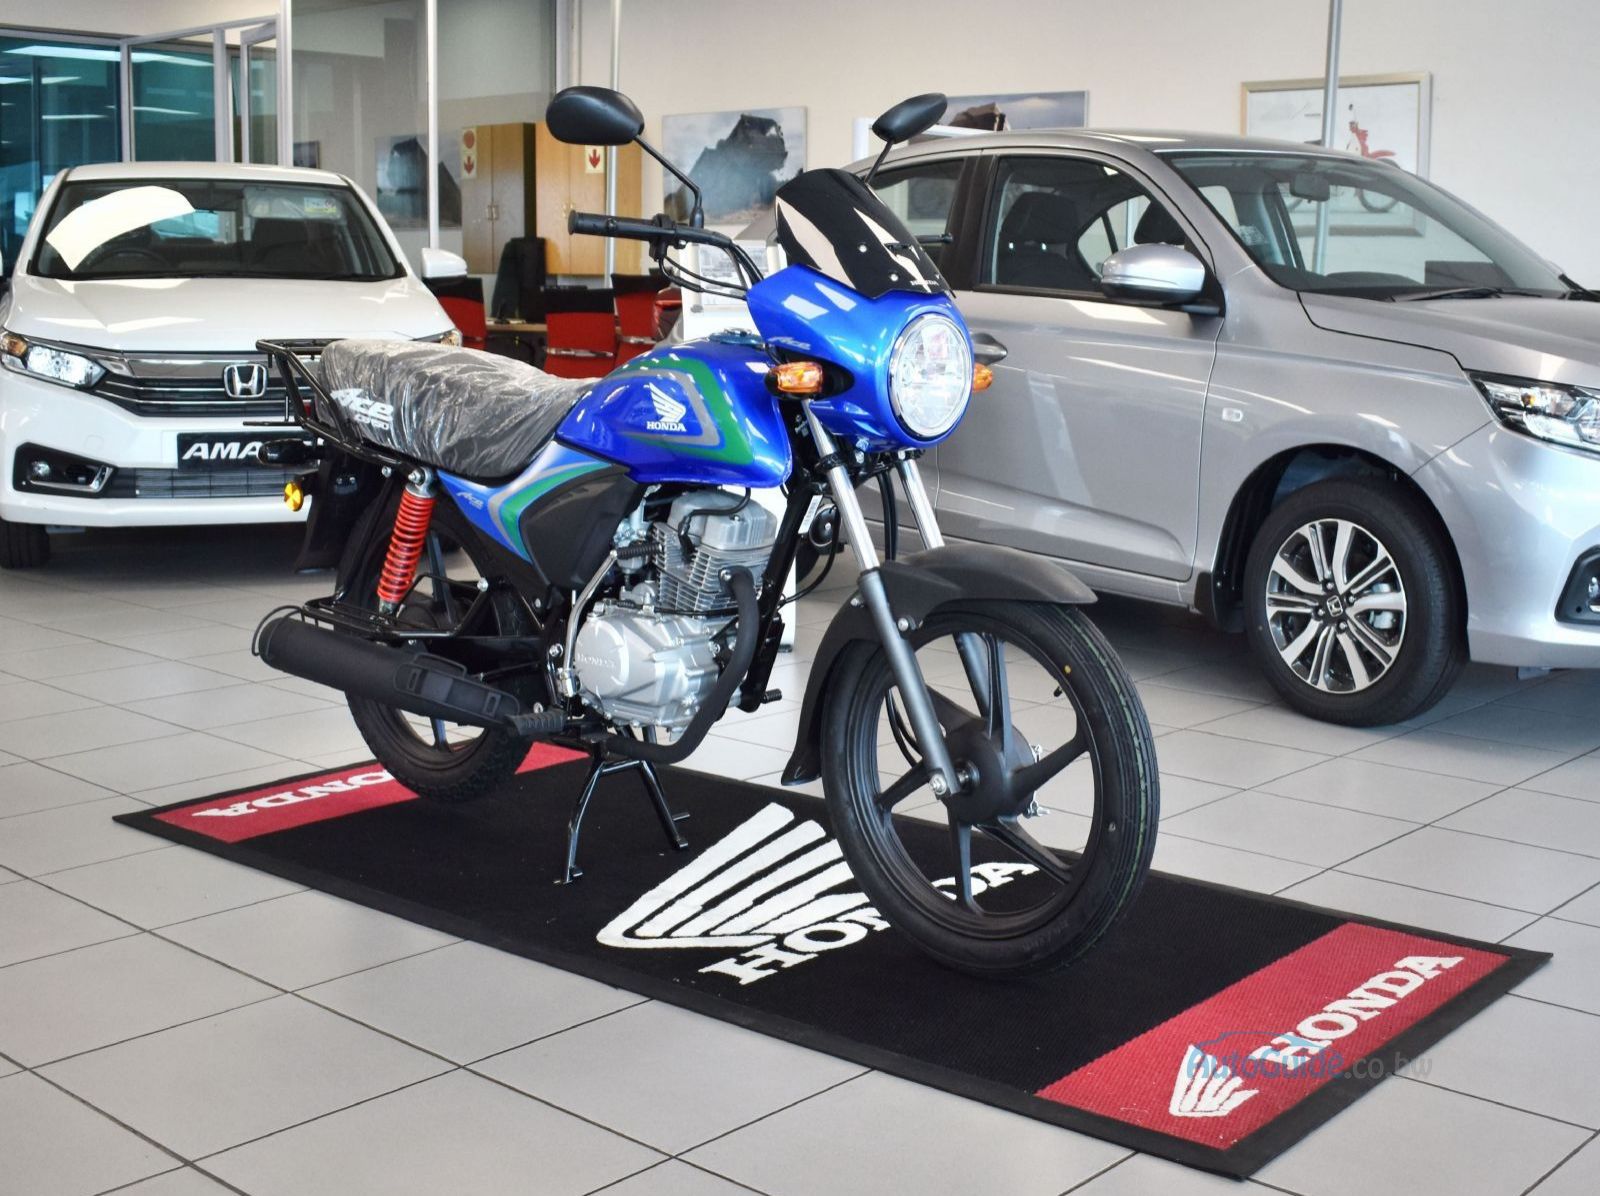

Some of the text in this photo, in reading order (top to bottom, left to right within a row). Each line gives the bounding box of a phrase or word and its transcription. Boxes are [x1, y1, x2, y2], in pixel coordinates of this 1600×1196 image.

[646, 421, 687, 432] HONDA
[191, 769, 395, 817] ONDA
[1249, 955, 1465, 1071] HONDA
